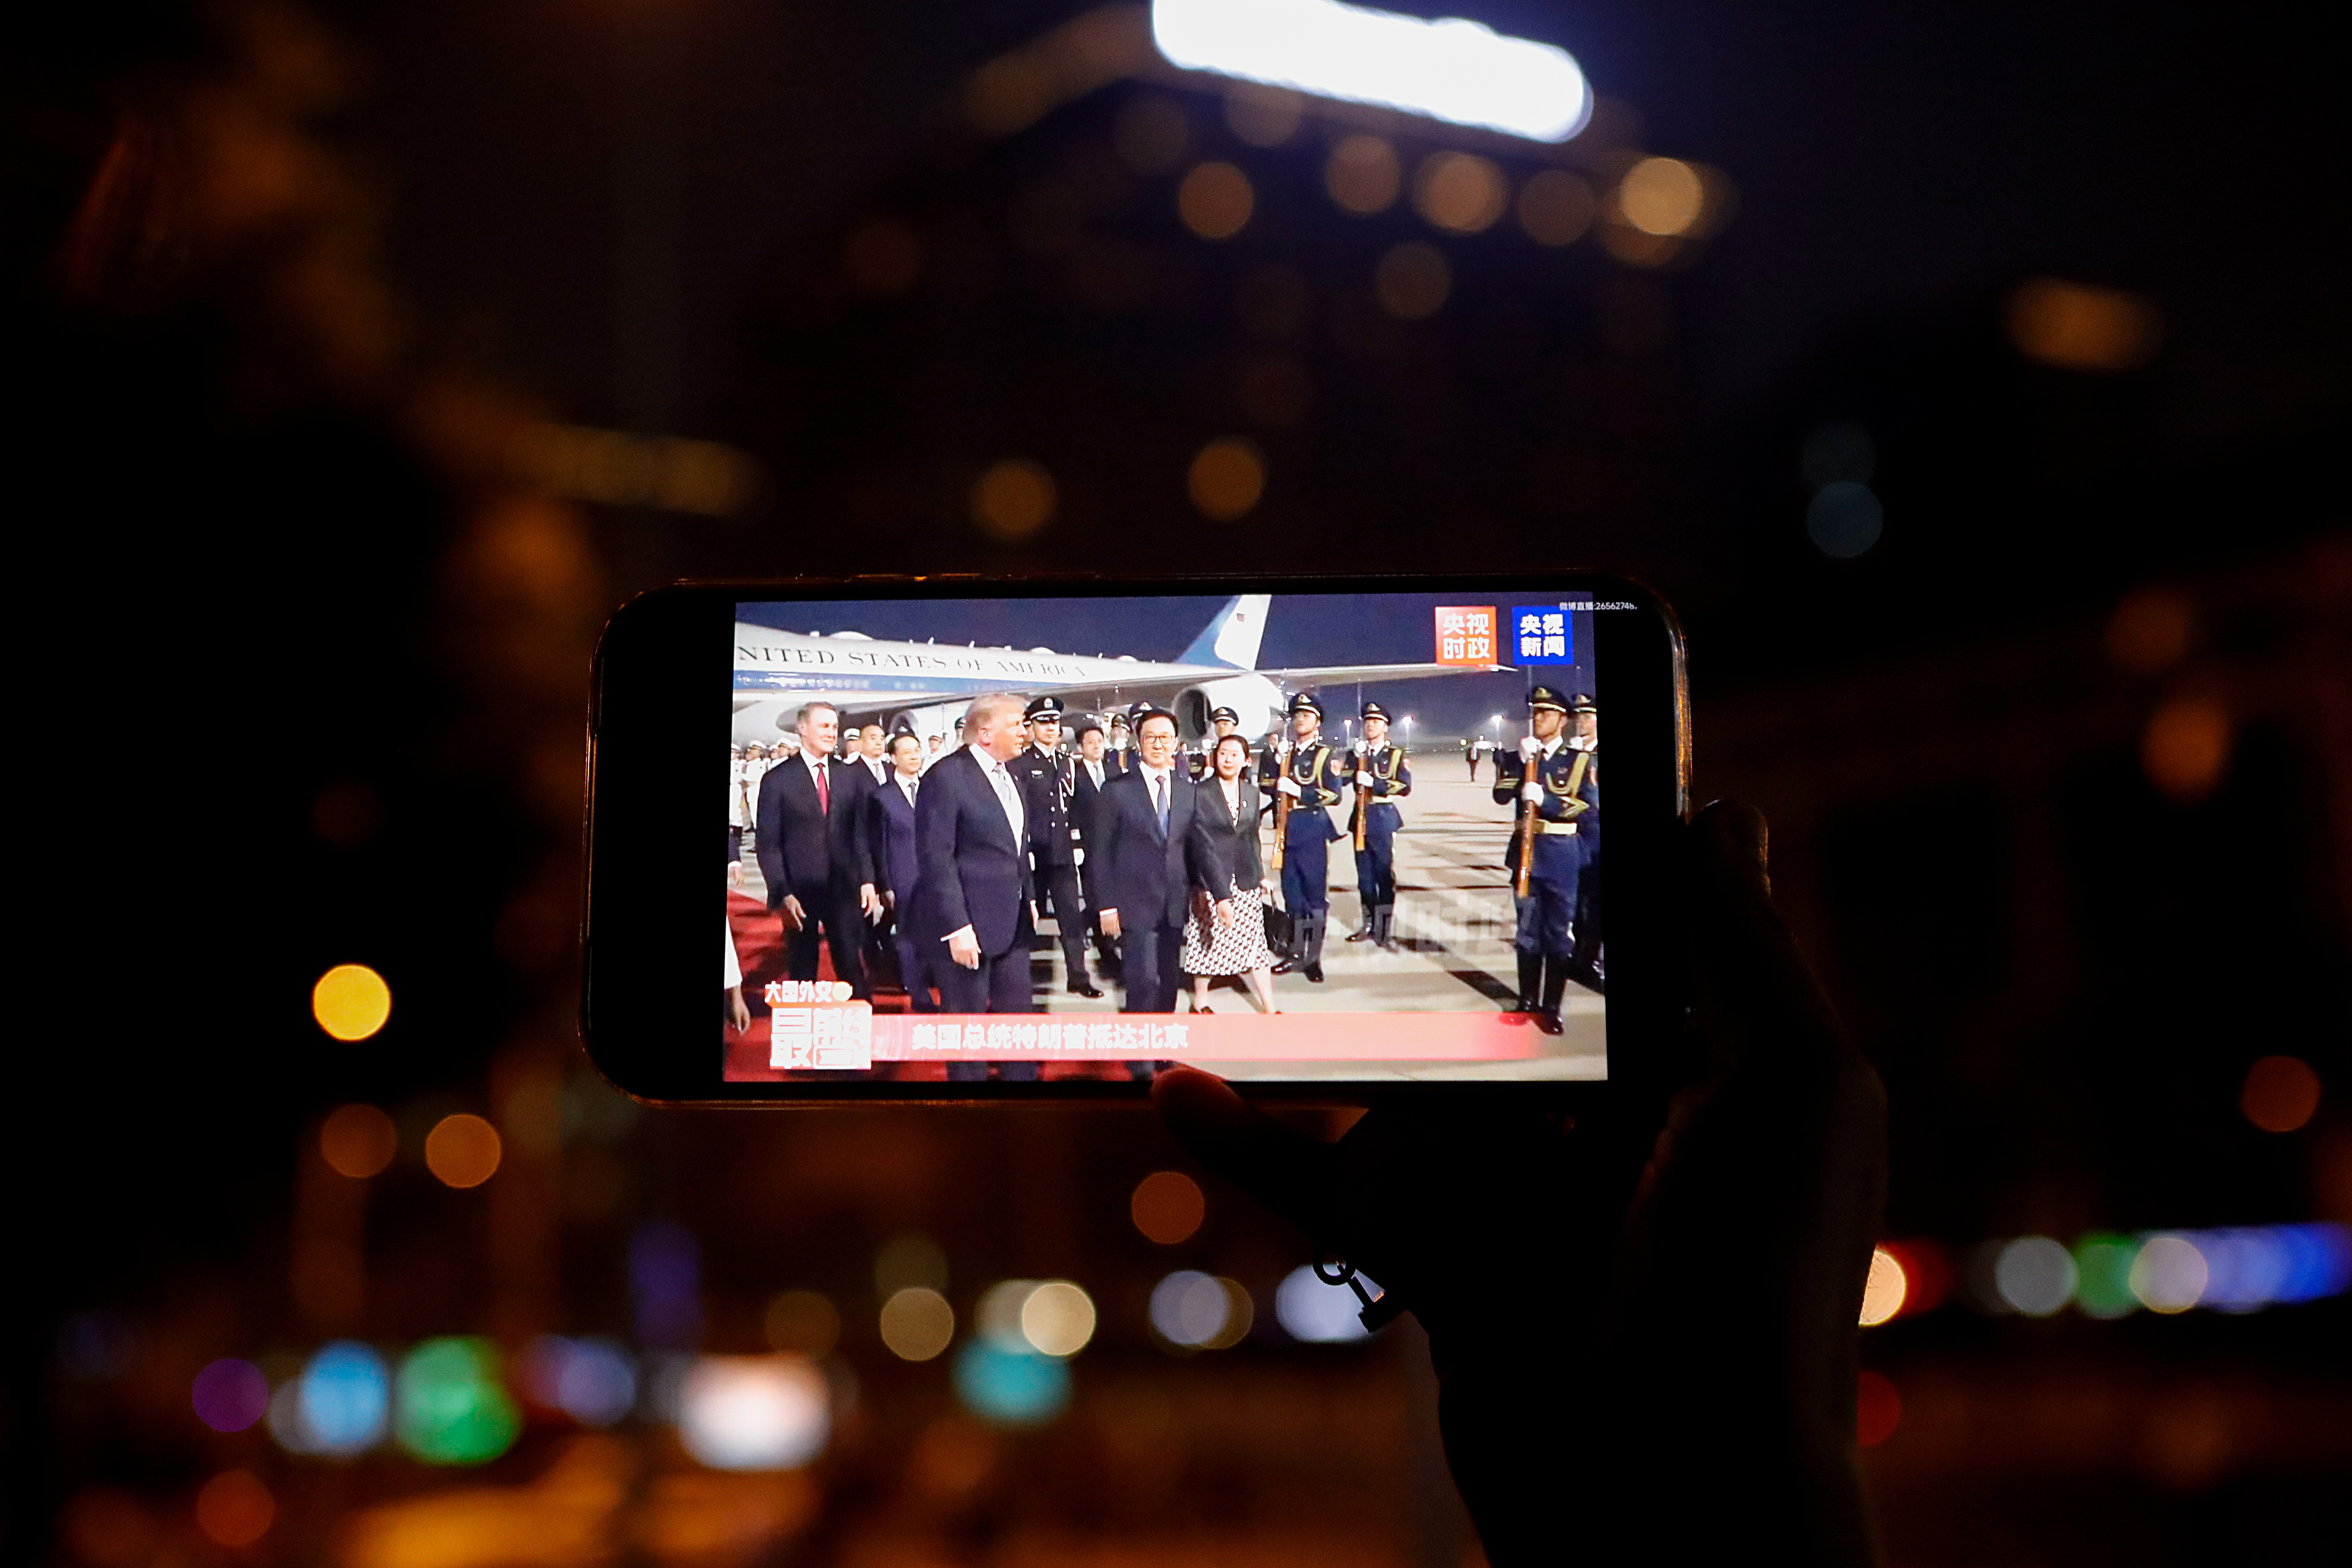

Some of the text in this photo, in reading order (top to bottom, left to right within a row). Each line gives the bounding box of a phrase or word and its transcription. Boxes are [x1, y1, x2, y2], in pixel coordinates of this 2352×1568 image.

[1444, 613, 1489, 635] 央视
[1521, 614, 1564, 635] 央视
[1444, 637, 1490, 659] 时政
[1521, 636, 1565, 657] 新闻
[849, 652, 947, 669] STATES
[957, 658, 984, 670] OF
[765, 981, 832, 1002] 大国外交
[912, 1023, 1189, 1050] 美国总统特朗普抵达北京
